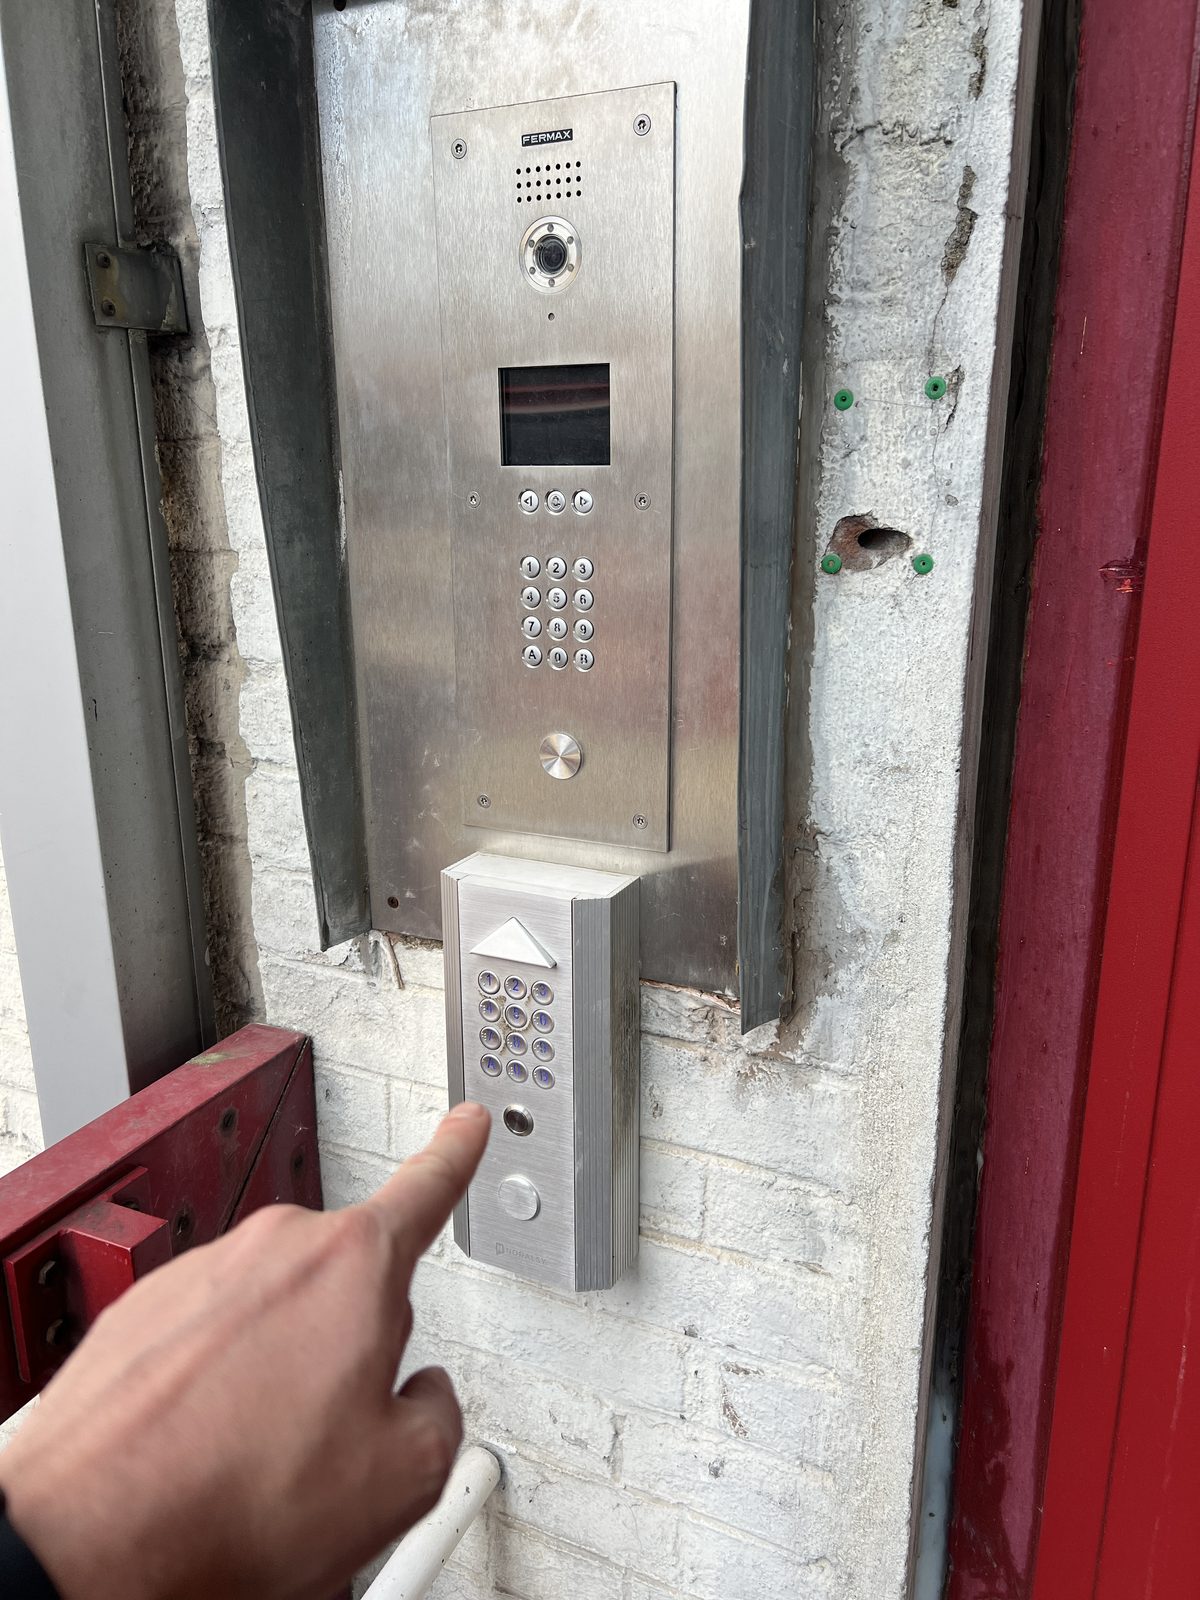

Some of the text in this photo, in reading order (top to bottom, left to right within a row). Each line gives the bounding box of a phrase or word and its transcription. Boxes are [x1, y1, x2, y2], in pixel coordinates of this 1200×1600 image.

[522, 130, 571, 145] FERMAX
[526, 561, 587, 575] 1 2 3
[526, 591, 587, 605] 4 5 6
[528, 621, 587, 635] 7 8 9
[528, 649, 588, 664] A 0 B
